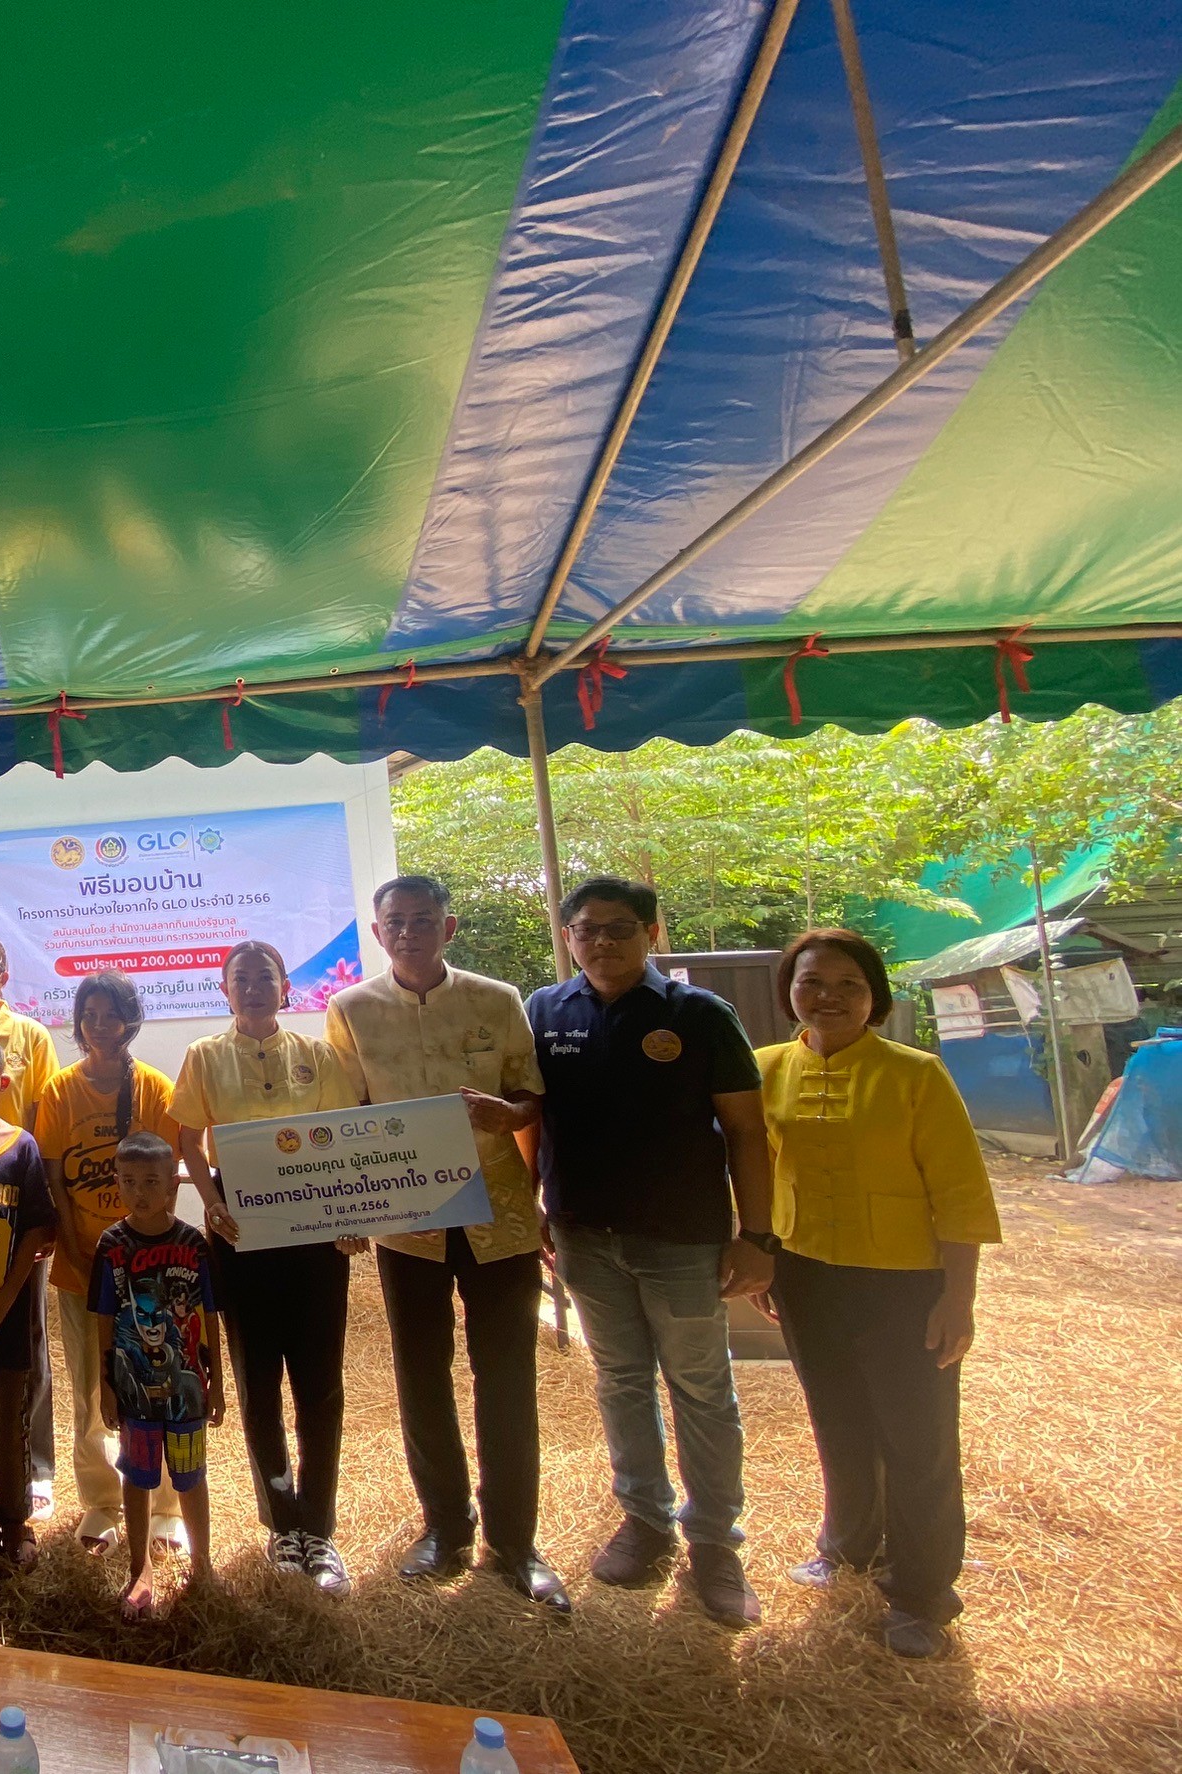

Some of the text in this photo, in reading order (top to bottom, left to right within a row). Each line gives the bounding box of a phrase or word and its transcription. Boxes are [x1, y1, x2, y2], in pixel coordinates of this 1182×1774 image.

[137, 831, 189, 852] GLO
[79, 868, 202, 896] พิธีมอบบ้าน
[18, 892, 271, 920] โครงการบ้านห่วงใยจากใจ GLO ประจำปี 2566
[44, 927, 248, 950] ร่วมกับกรมการพัฒนาชุมชน กระทรวงมหาดไทย
[73, 953, 221, 971] งบประมาณ 200,000 บาท
[340, 1120, 378, 1138] GLO
[277, 1149, 418, 1176] ขอขอบคุณ ผู้สนับสนุน
[235, 1166, 472, 1208] โครงการบ้านห่วงใยจากใจ GLO
[323, 1199, 390, 1216] ปี พ.ศ.2566
[289, 1210, 431, 1233] สนับสนุนโดย สำนักงานสลากกินแบ่งรัฐบาล
[165, 1266, 199, 1284] KNIGHT
